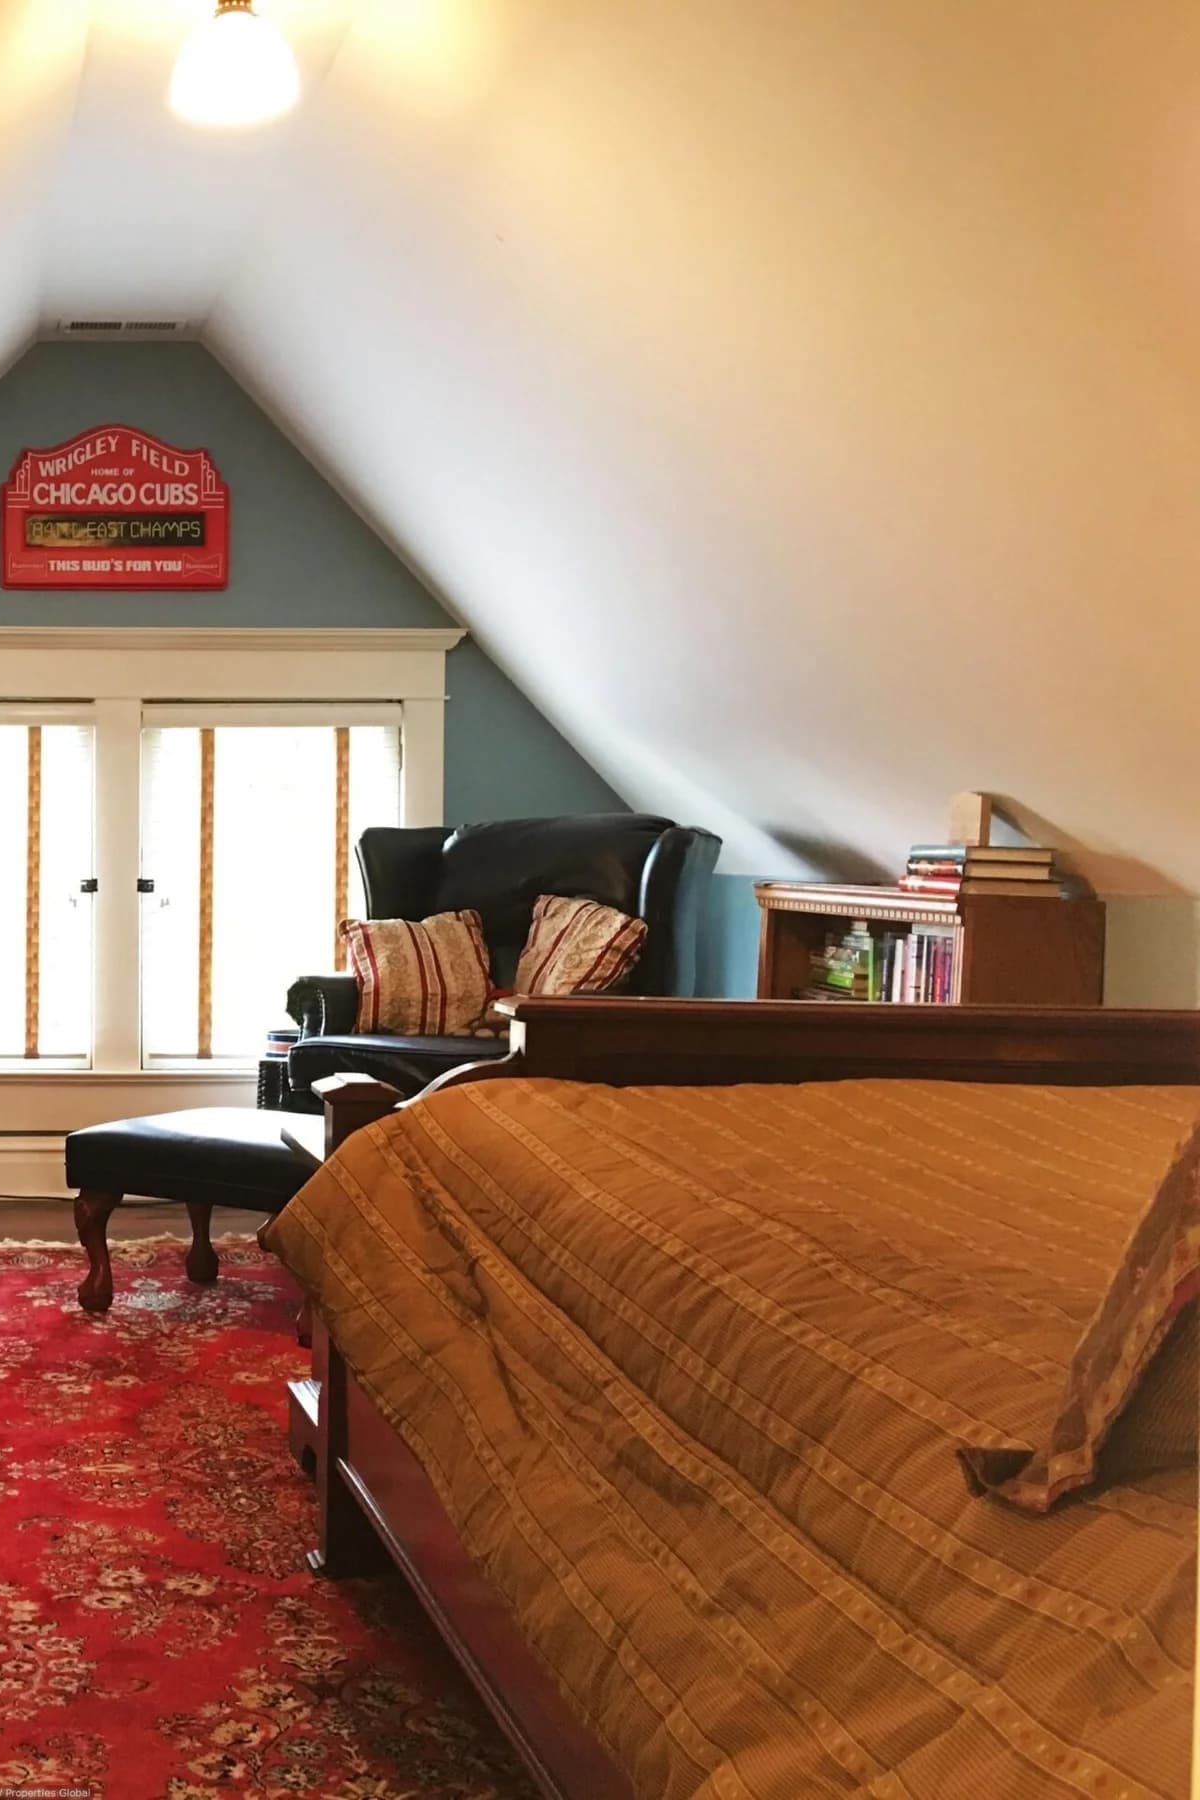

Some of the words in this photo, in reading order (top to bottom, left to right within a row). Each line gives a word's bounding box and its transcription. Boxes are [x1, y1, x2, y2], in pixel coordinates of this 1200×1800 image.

[38, 435, 120, 478] WRIGLEY
[131, 439, 190, 477] FIELD
[91, 468, 120, 476] HOME
[122, 468, 135, 476] OF
[32, 483, 136, 506] CHICAGO
[139, 483, 199, 506] CUBS
[86, 521, 128, 538] EAST
[130, 521, 201, 539] CHAMPS
[48, 560, 81, 572] THIS
[82, 558, 124, 572] BUD'S
[126, 560, 152, 572] FOR
[155, 560, 183, 572] YOU
